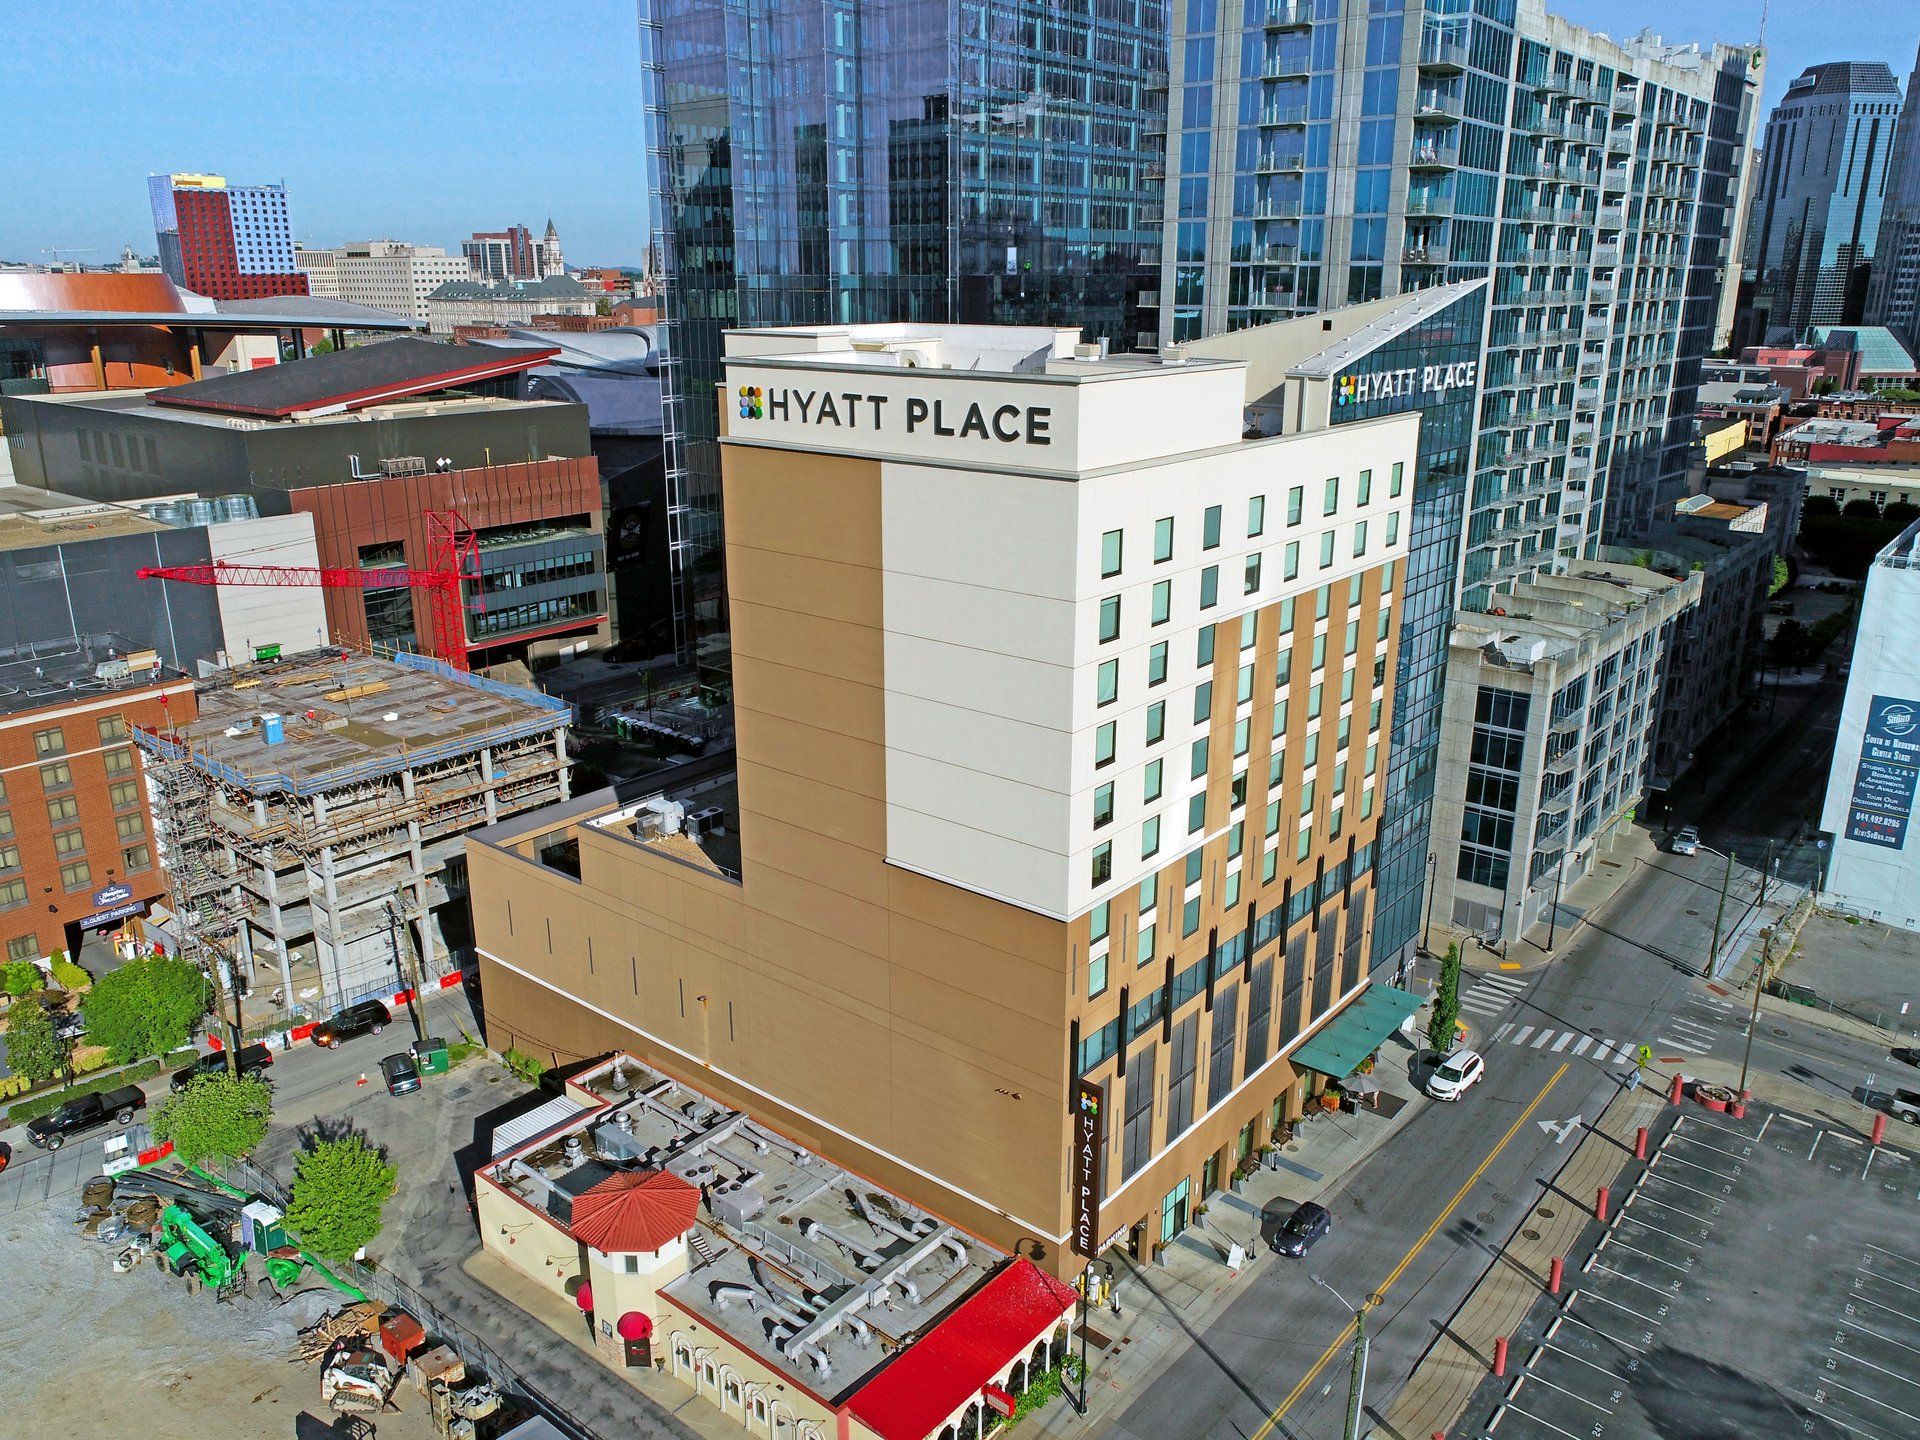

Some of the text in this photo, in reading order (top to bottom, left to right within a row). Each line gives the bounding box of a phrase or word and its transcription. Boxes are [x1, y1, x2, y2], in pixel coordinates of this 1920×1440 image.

[1356, 361, 1476, 403] HYATT PLACE
[768, 387, 1052, 445] HYATT PLACE
[89, 905, 136, 924] GUEST PARKING
[1082, 1117, 1094, 1181] HYATT
[1079, 1186, 1091, 1250] PLACE
[1097, 1223, 1128, 1256] PARKING
[1671, 1280, 1682, 1292] 242
[1657, 1303, 1669, 1316] 243
[1642, 1331, 1654, 1344] 244
[1627, 1358, 1639, 1372] 245
[1610, 1389, 1622, 1404] 246
[1815, 1388, 1826, 1403] 230
[1592, 1422, 1604, 1438] 247
